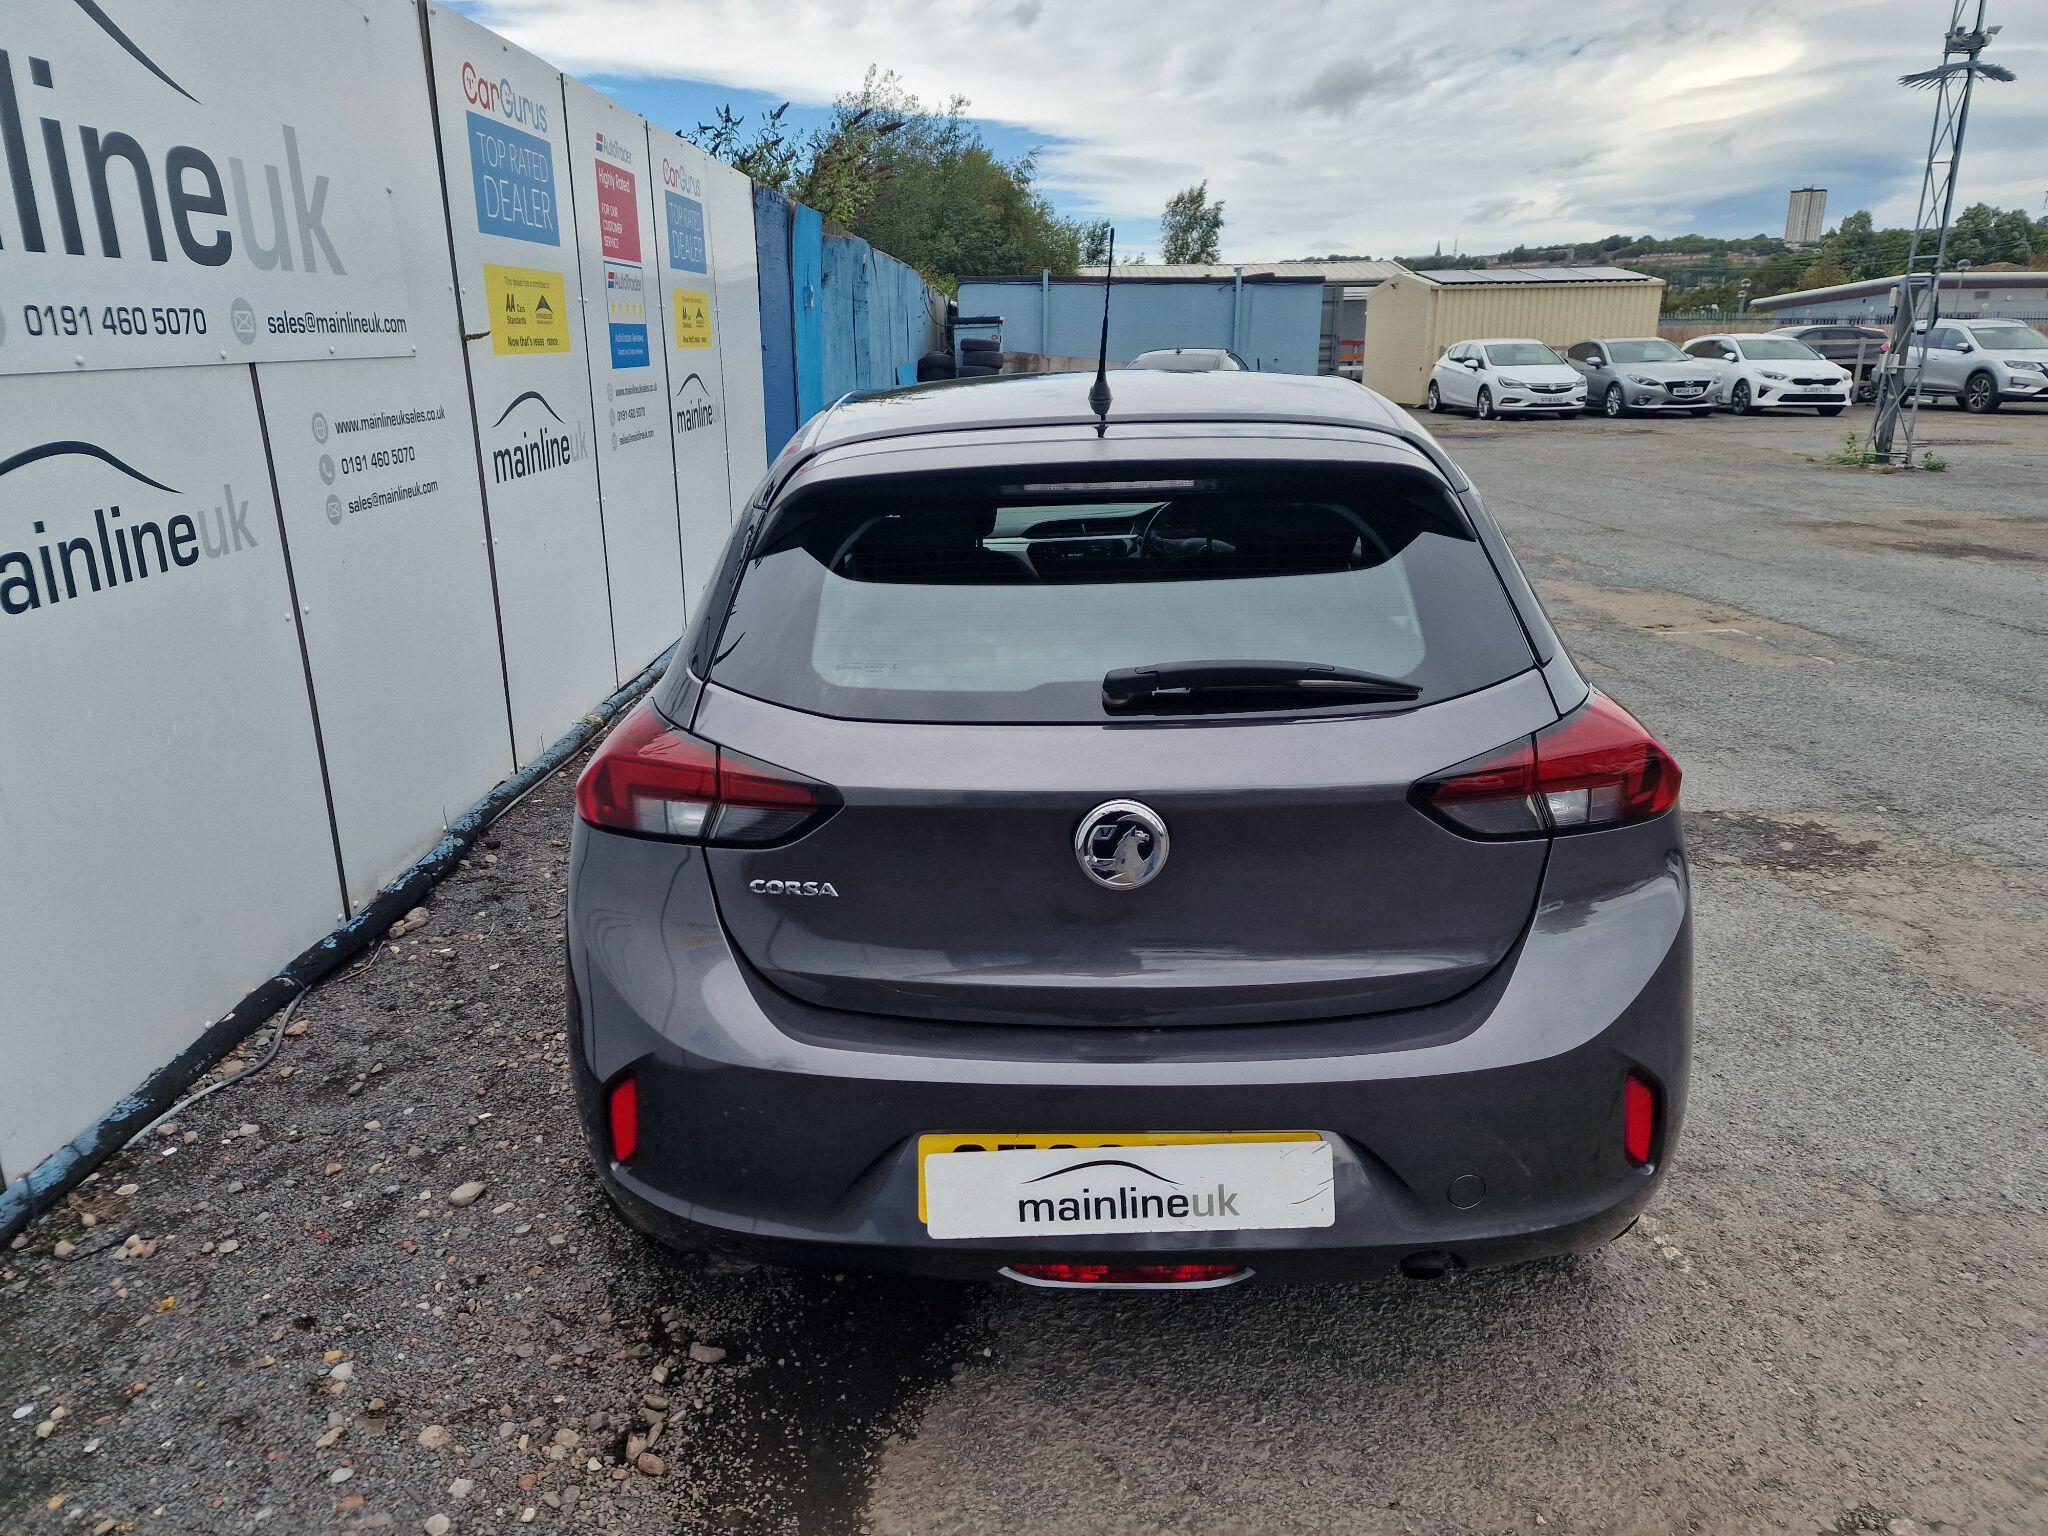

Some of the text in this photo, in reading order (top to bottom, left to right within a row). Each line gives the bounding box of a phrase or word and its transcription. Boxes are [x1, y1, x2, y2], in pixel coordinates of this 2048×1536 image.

[461, 62, 548, 133] CarGurus
[0, 48, 348, 276] lineuk
[476, 132, 549, 183] TOP RATED
[598, 167, 630, 193] Highly Rated
[662, 158, 701, 197] CarGurus
[483, 175, 554, 230] DEALER
[672, 230, 704, 263] DEALER
[505, 293, 516, 313] AA
[23, 305, 208, 336] 0191 460 5070
[267, 311, 408, 335] sales@mainlineuk.com
[507, 335, 520, 347] Now
[334, 405, 446, 435] www.mainlineuksales.co.uk
[676, 394, 722, 434] mainlineuk
[341, 446, 416, 475] 0191 460 5070
[493, 421, 589, 484] mainlineuk
[348, 480, 439, 514] sales@mainlineuk.com
[0, 483, 259, 615] ainlineuk
[748, 879, 839, 898] CORSA
[1018, 1184, 1241, 1223] mainlineuk
